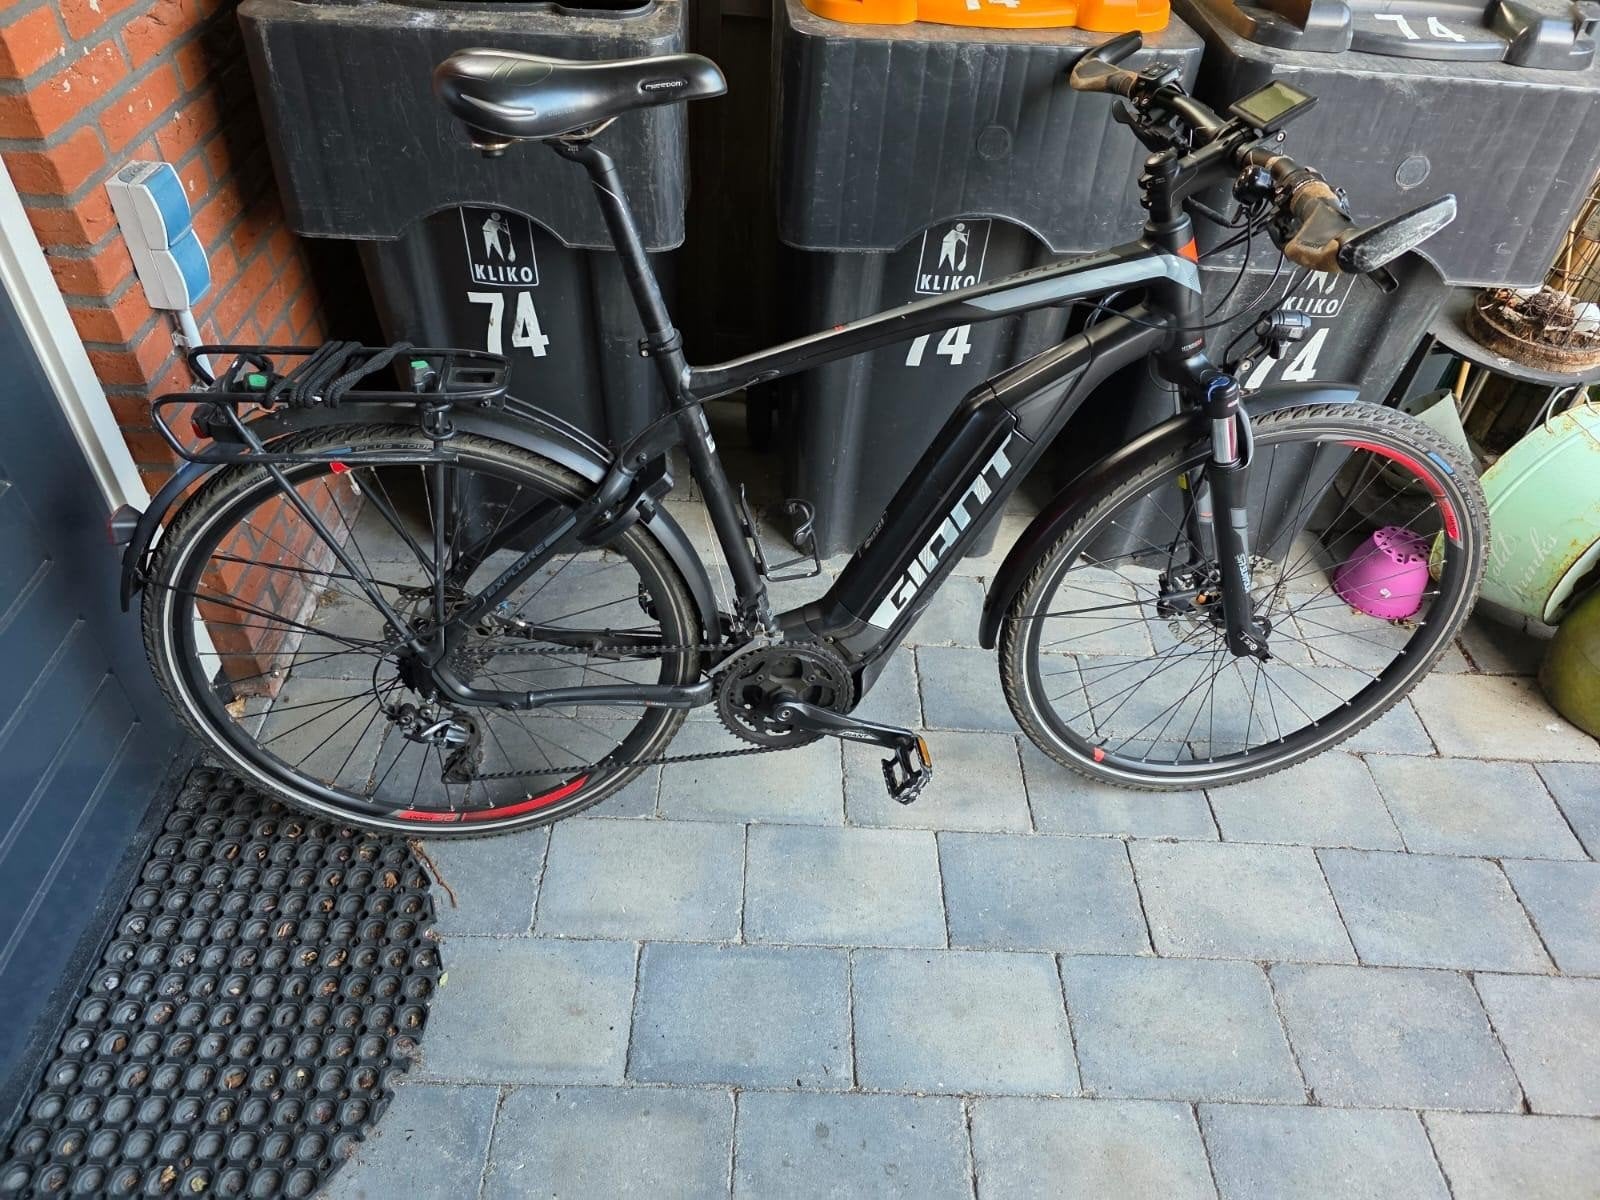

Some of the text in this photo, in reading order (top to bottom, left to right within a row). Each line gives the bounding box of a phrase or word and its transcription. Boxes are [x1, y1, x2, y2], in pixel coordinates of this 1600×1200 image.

[1374, 13, 1466, 42] 74
[474, 263, 534, 283] KLIKO
[920, 273, 976, 291] KLIKO
[1282, 296, 1339, 314] KLIKO
[467, 291, 550, 357] 74
[868, 432, 1013, 630] GIANT
